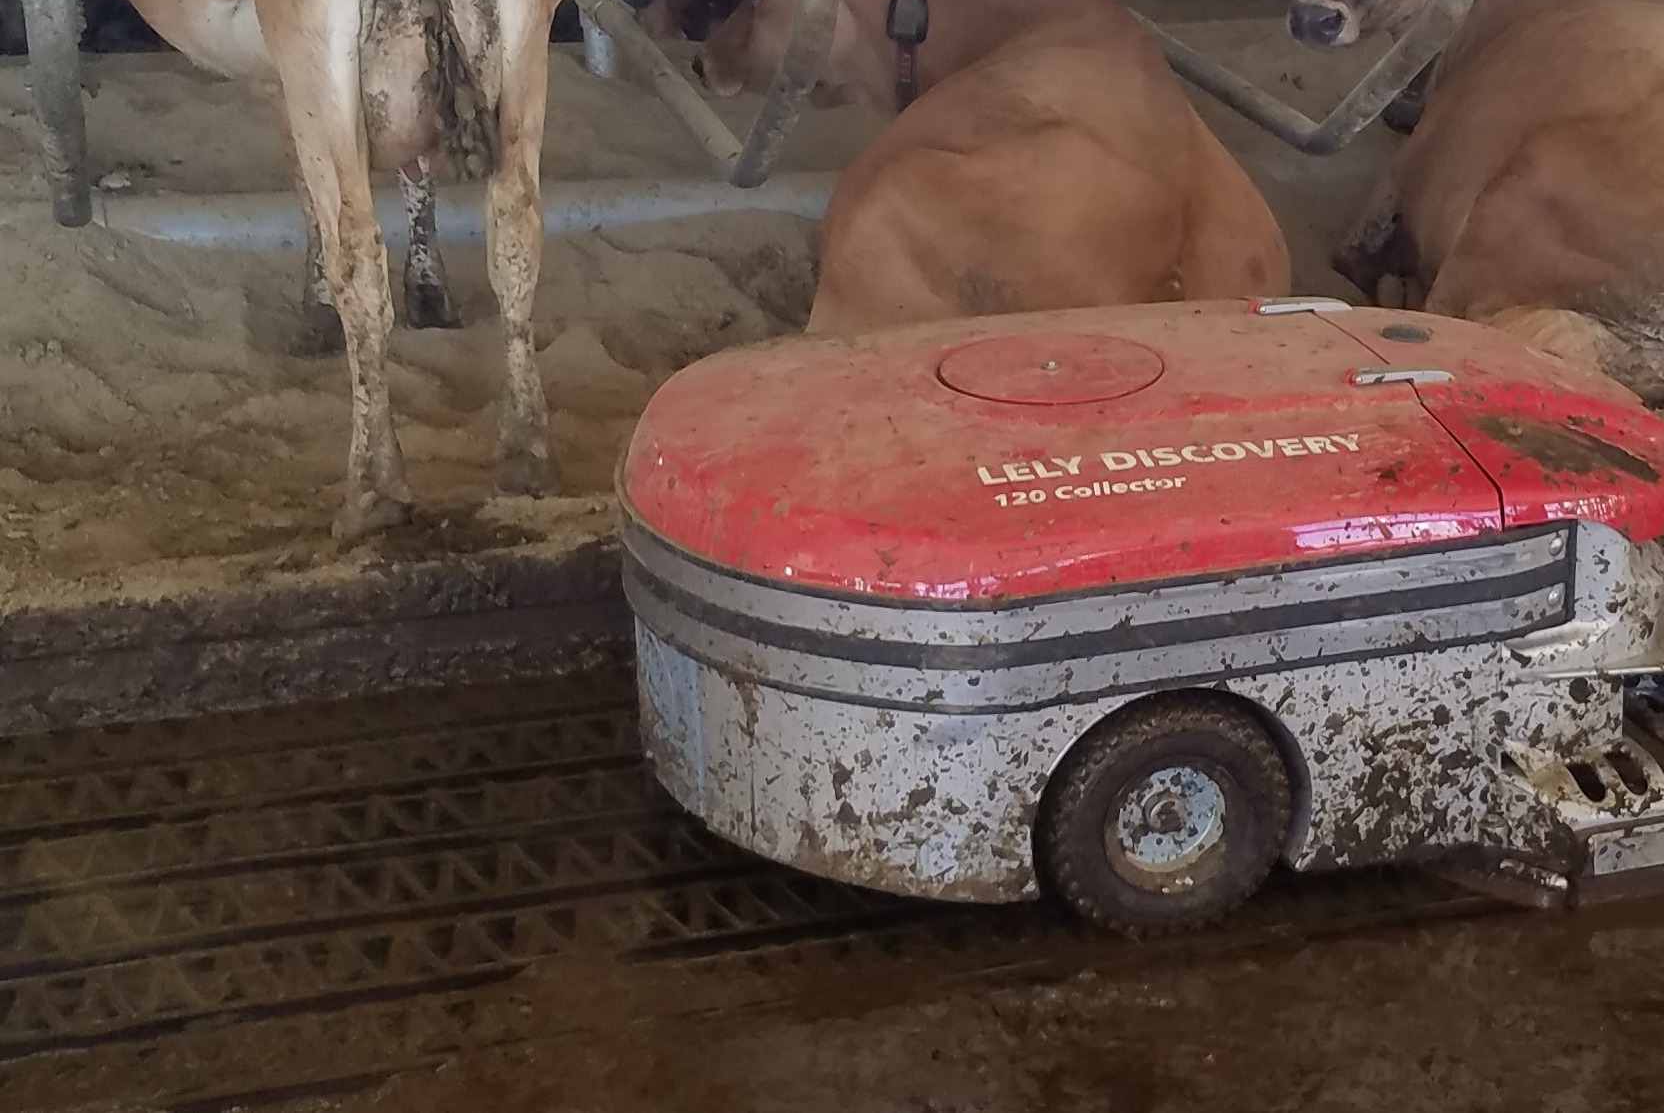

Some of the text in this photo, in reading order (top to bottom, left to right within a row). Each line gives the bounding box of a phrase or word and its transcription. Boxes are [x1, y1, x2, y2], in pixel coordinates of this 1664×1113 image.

[977, 433, 1361, 486] LELY DISCOVERY
[994, 474, 1187, 508] 120 Collector
